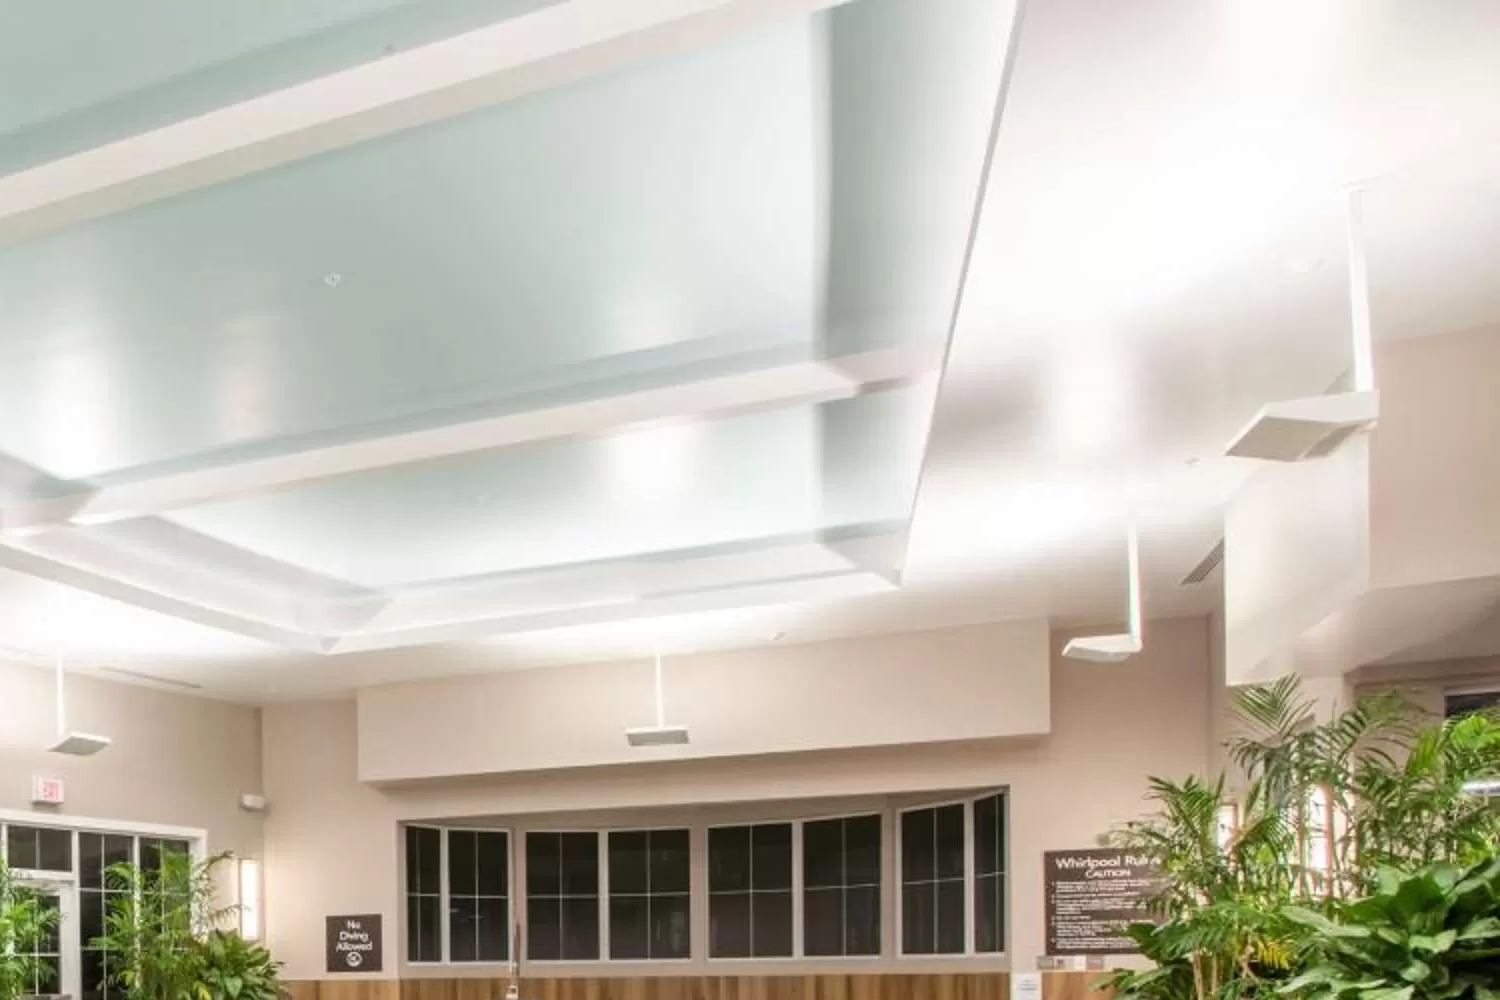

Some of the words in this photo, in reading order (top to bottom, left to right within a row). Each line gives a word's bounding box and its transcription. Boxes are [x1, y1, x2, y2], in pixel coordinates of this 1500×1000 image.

[1055, 855, 1121, 869] Whirlpool
[1084, 868, 1132, 878] CAUTION
[346, 920, 361, 930] No
[339, 930, 369, 942] Diving
[335, 941, 373, 952] Allowed
